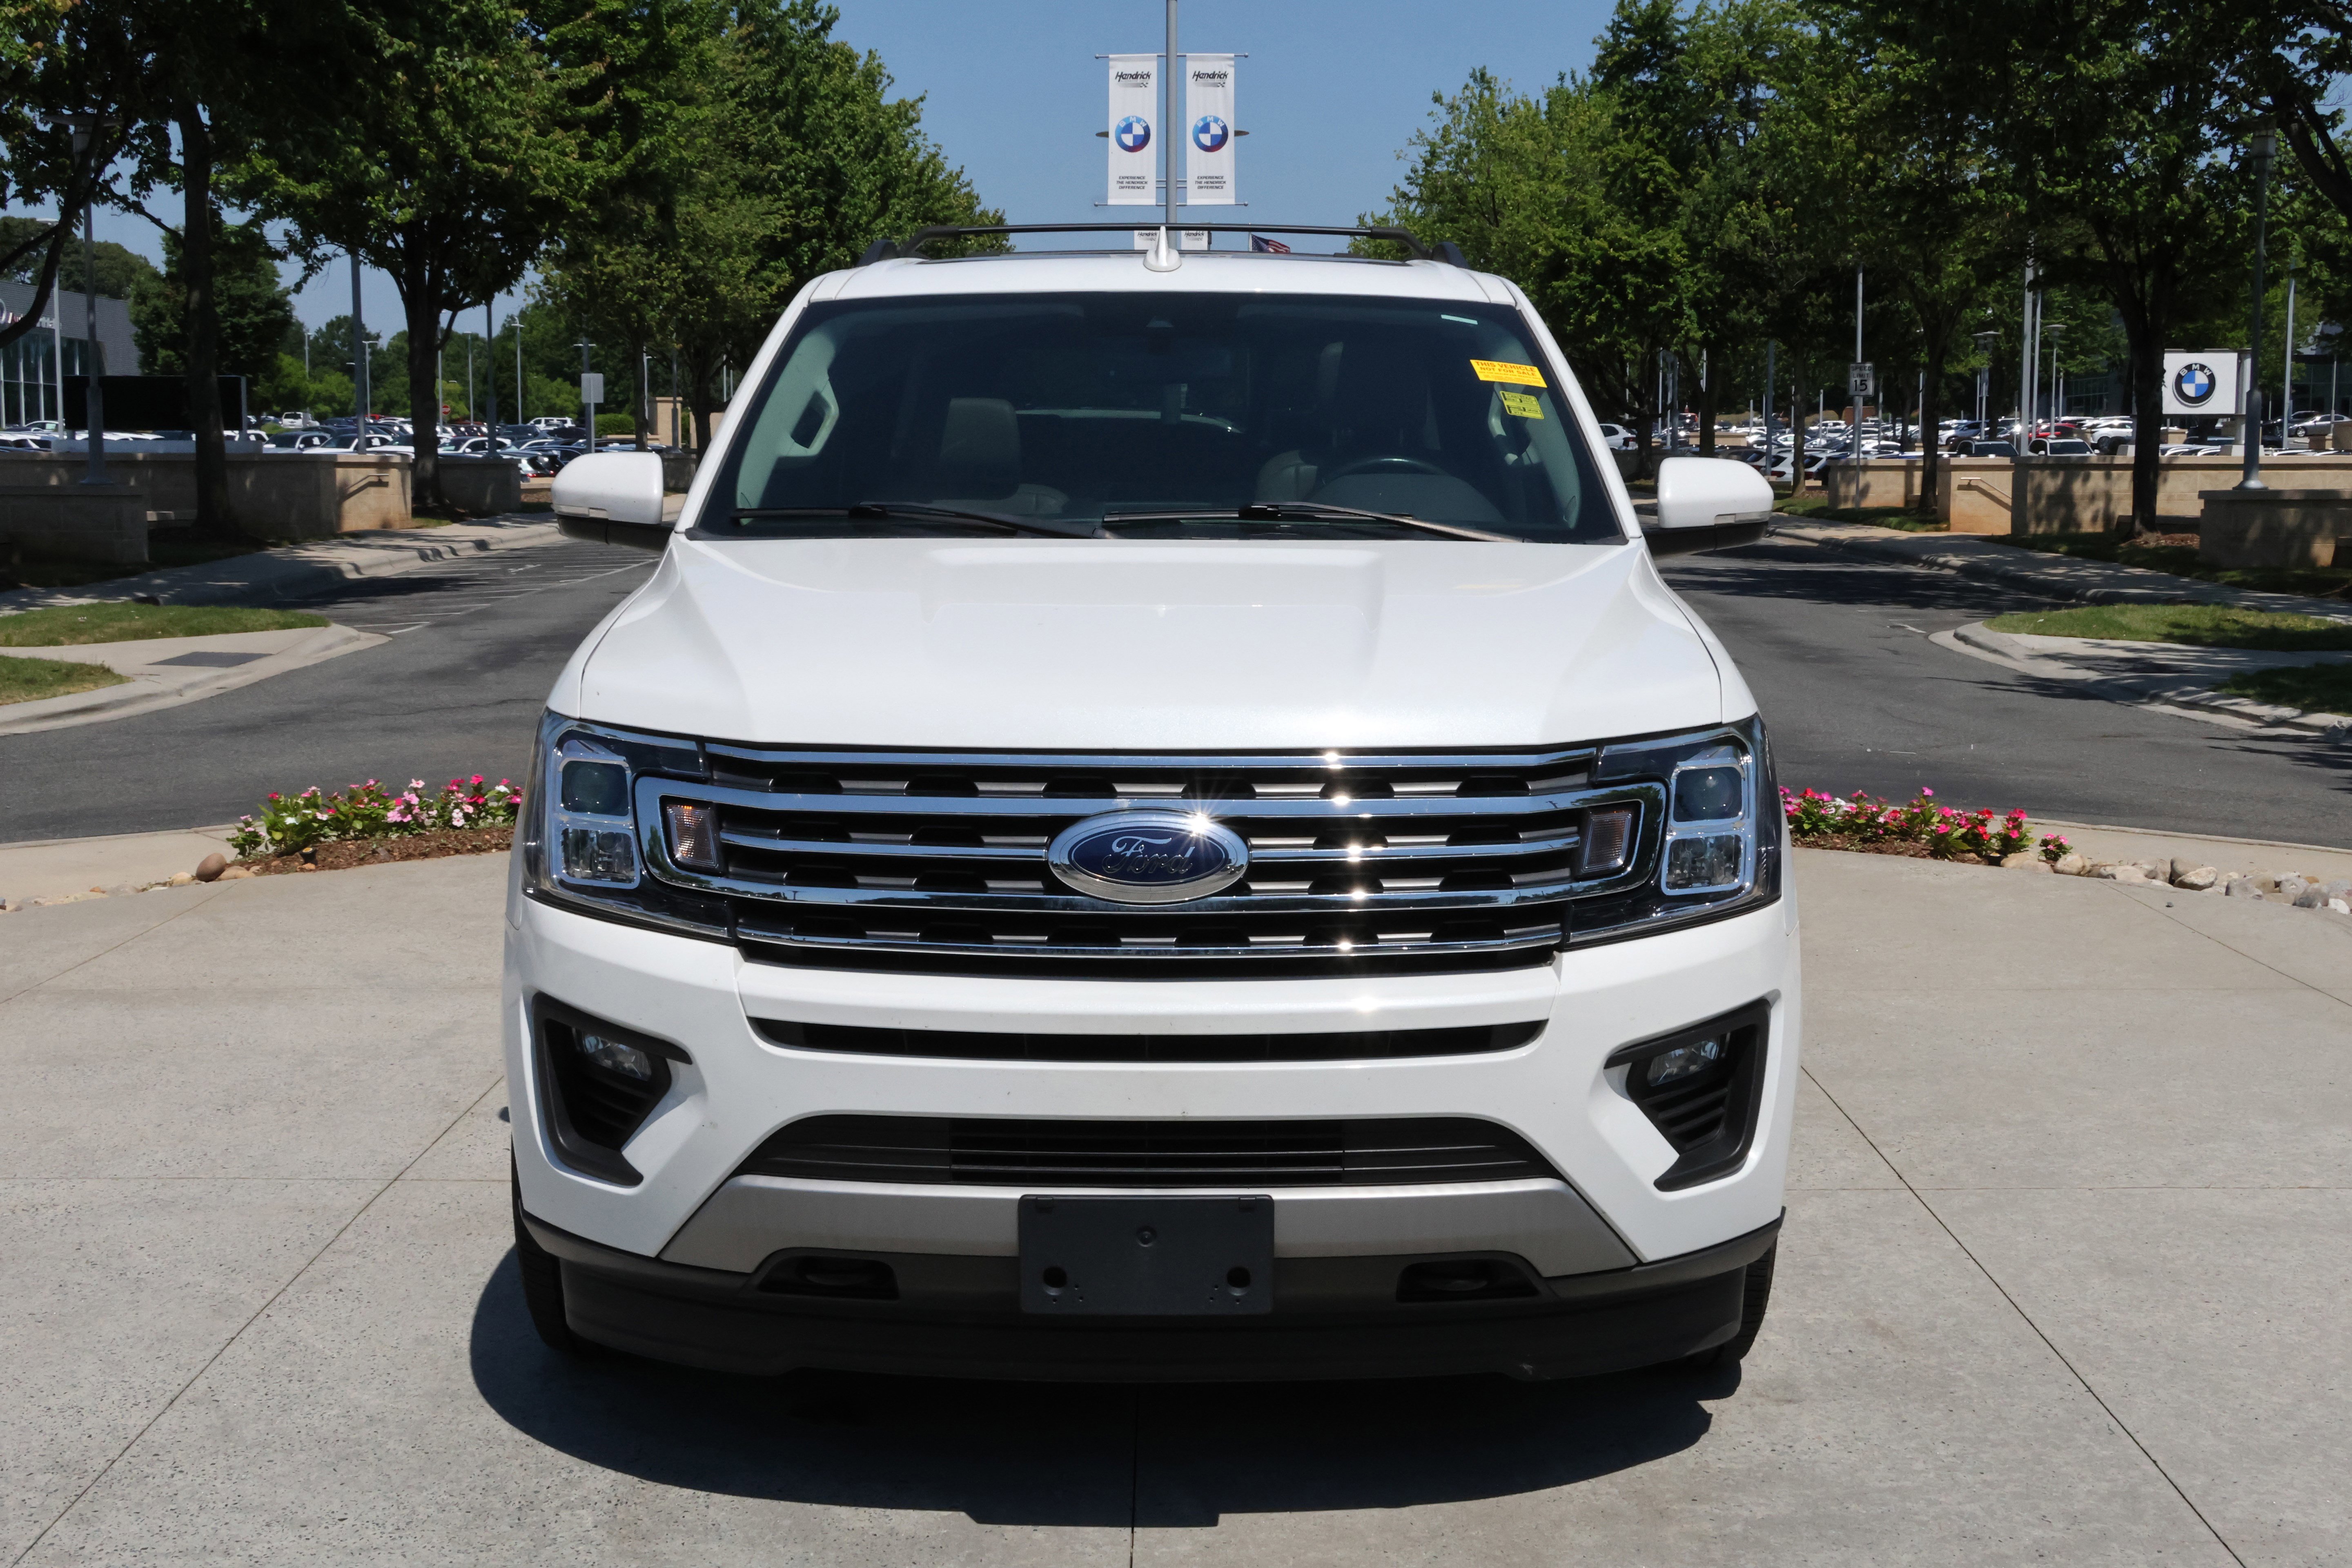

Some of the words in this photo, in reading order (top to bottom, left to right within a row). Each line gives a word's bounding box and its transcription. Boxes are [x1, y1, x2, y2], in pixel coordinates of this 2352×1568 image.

[1115, 71, 1152, 82] Hendrick
[1192, 71, 1229, 81] Hendrick
[1119, 116, 1147, 127] BMW
[1196, 116, 1225, 127] BMW
[1497, 363, 1536, 372] VEHICLE
[2179, 364, 2212, 376] BMW
[1854, 379, 1867, 392] 15
[1103, 835, 1195, 874] Ford
